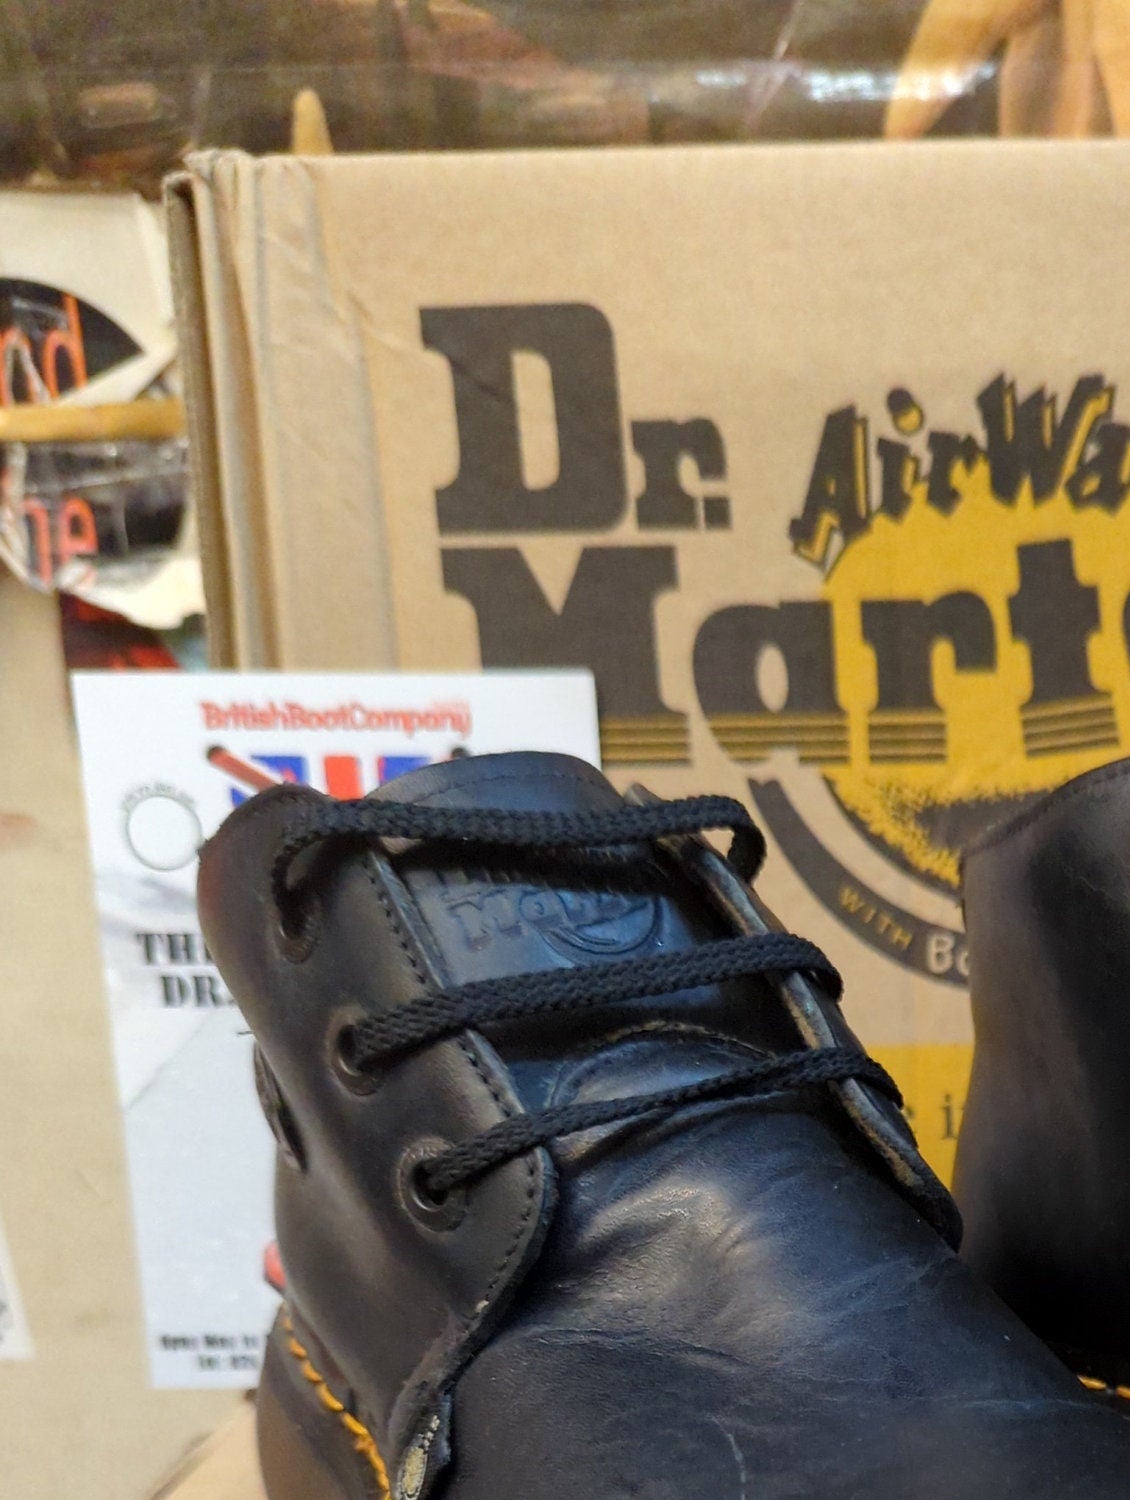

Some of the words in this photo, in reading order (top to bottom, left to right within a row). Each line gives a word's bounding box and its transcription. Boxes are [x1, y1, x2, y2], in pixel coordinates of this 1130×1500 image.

[418, 302, 732, 535] Dr.
[135, 932, 214, 965] TH
[838, 884, 914, 951] WITH
